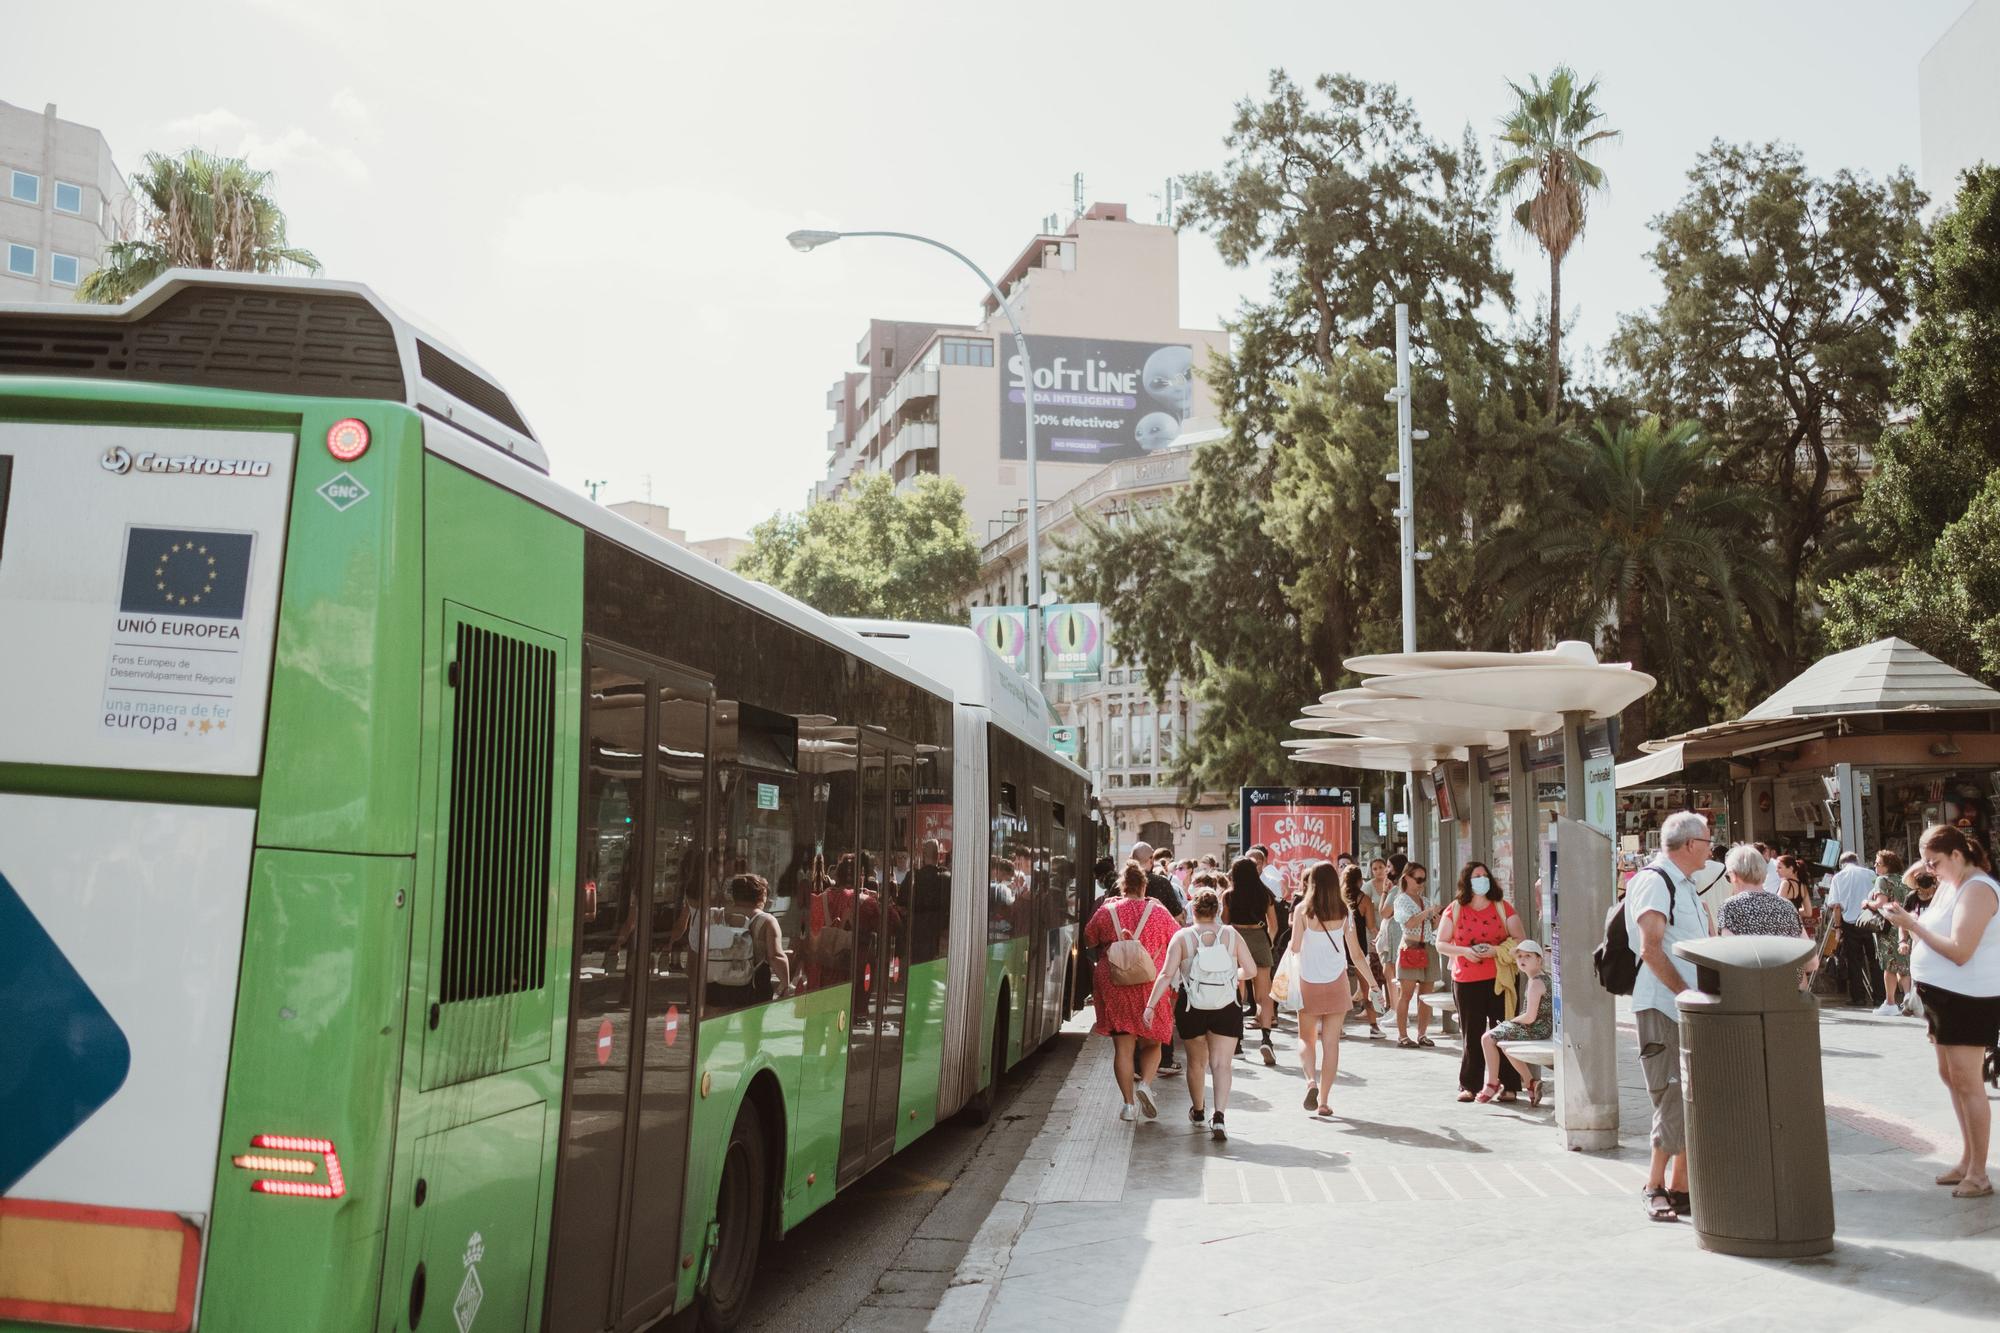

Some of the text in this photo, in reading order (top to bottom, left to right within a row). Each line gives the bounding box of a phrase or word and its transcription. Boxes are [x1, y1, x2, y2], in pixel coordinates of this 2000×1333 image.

[1053, 394, 1124, 407] INTELIGENTE
[135, 452, 272, 477] Castrosua
[328, 485, 358, 499] GNC
[117, 618, 240, 640] UNIÓ EUROPEA
[112, 655, 190, 669] Fons Europeu de
[110, 667, 236, 685] Desenvolupament Regional
[106, 700, 231, 718] una manera de fer
[104, 713, 177, 734] europa
[1275, 816, 1325, 834] CA NA
[1270, 832, 1332, 857] PAULINA
